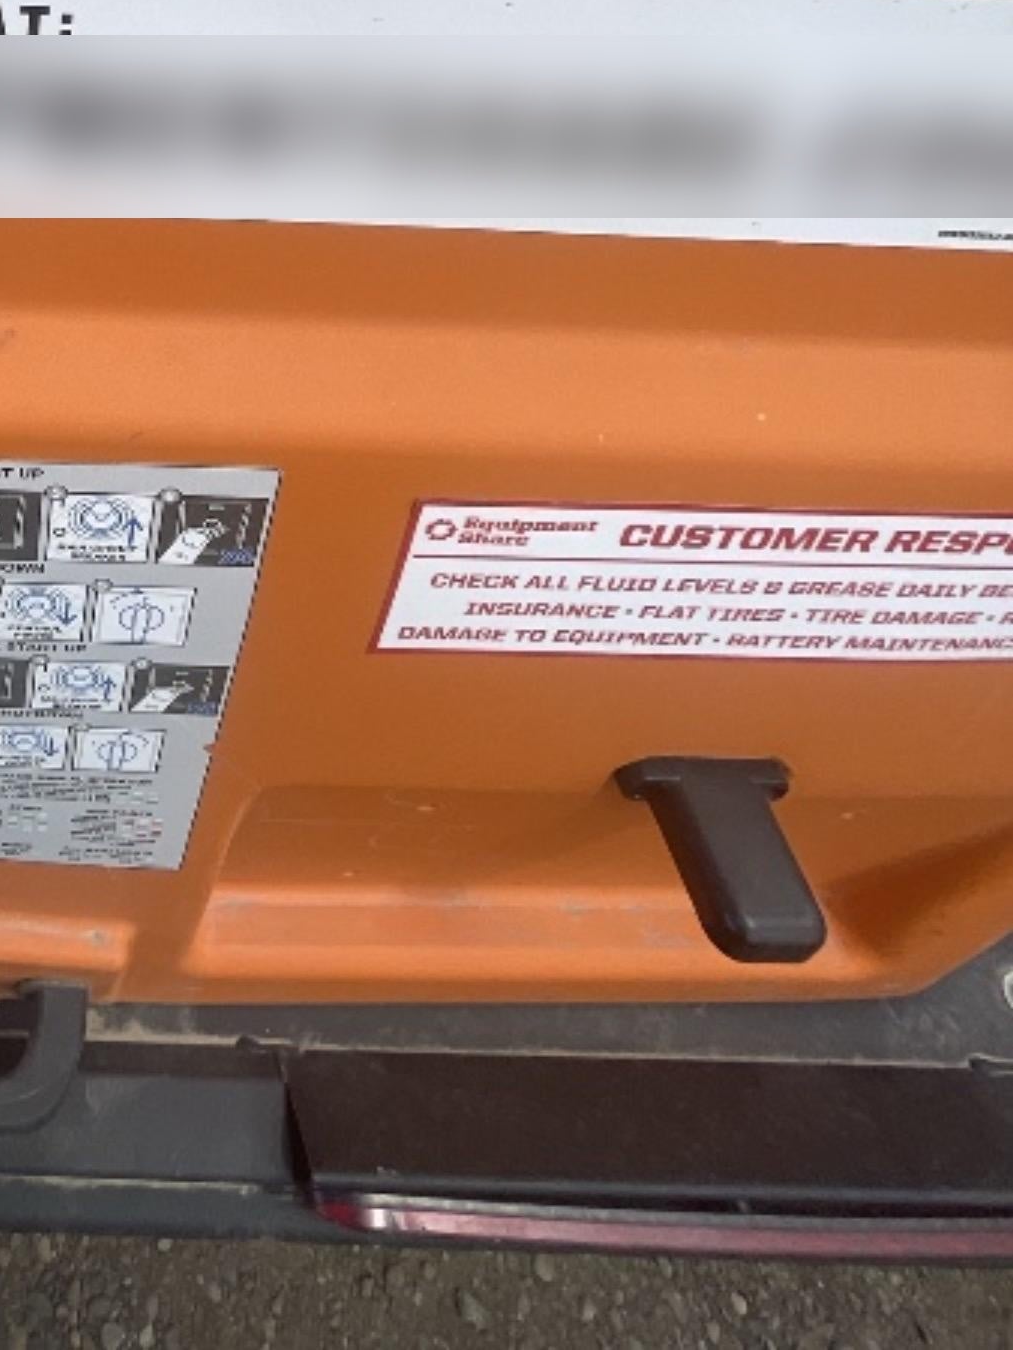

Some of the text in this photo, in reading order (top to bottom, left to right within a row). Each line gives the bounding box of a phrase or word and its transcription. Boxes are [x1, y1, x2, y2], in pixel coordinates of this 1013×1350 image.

[19, 467, 45, 480] UP
[619, 524, 880, 553] CUSTOMER
[430, 572, 519, 589] CHECK
[524, 575, 570, 590] ALL
[577, 576, 657, 592] FLUID
[662, 578, 758, 595] LEVELS
[788, 581, 892, 598] GREASE
[896, 583, 978, 599] DAILY
[464, 602, 620, 619] INSURANCE
[638, 605, 701, 619] FLAT
[707, 607, 786, 622] TIRES
[805, 608, 867, 623] TIRE
[870, 610, 984, 625] DAMAGE
[397, 626, 507, 643] DAMAGE
[514, 629, 547, 643] TO
[552, 629, 710, 646] EQUIPMENT
[726, 632, 840, 649] BATTERY
